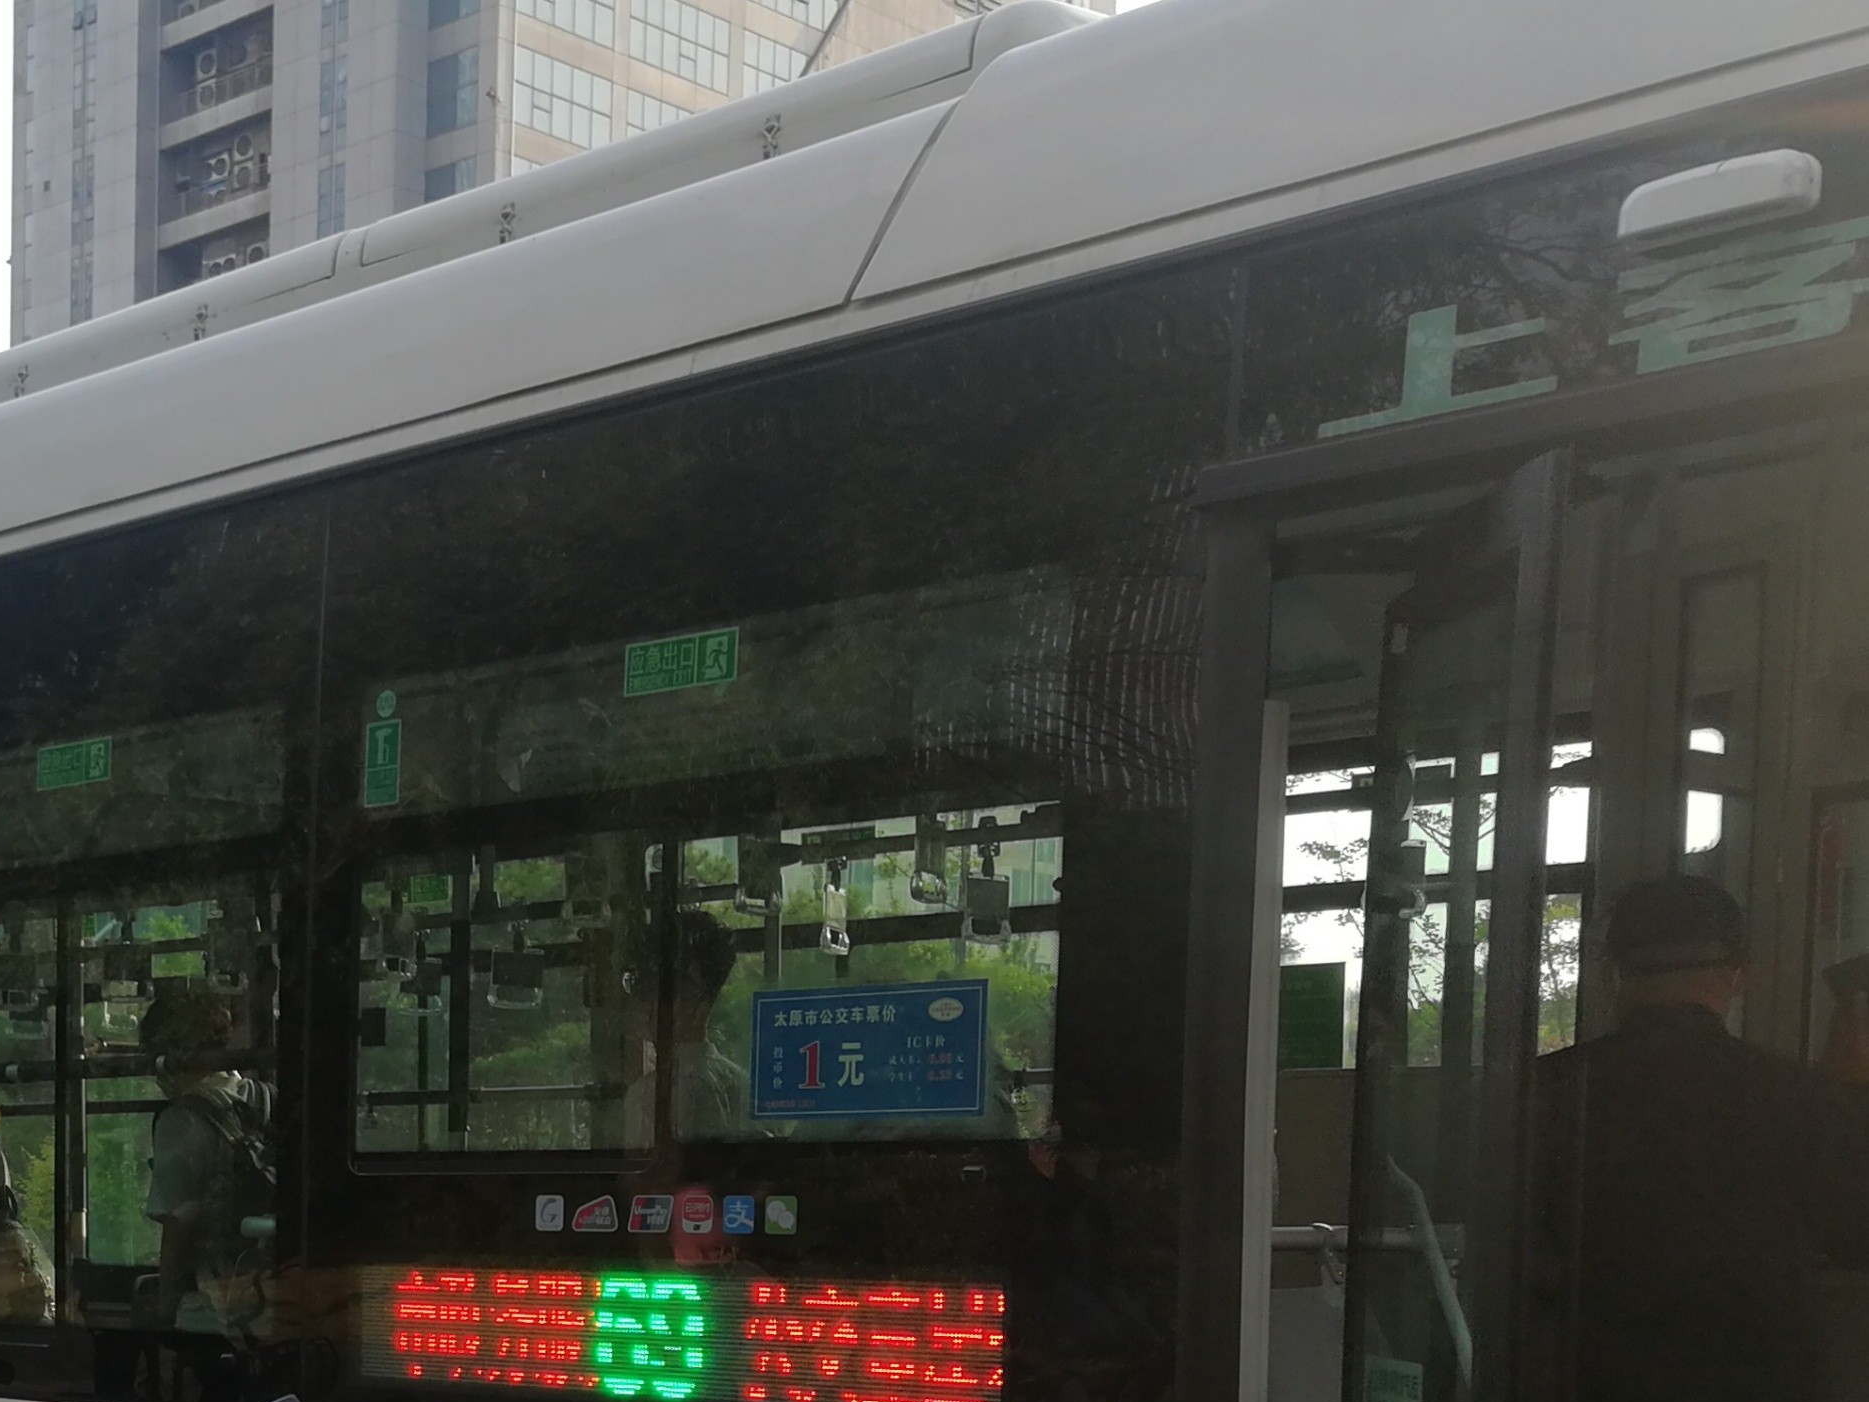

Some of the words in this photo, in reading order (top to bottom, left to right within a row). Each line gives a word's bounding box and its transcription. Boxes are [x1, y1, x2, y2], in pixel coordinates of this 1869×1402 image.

[630, 643, 694, 675] 应急出口
[774, 1004, 897, 1028] 太原市公交车票价
